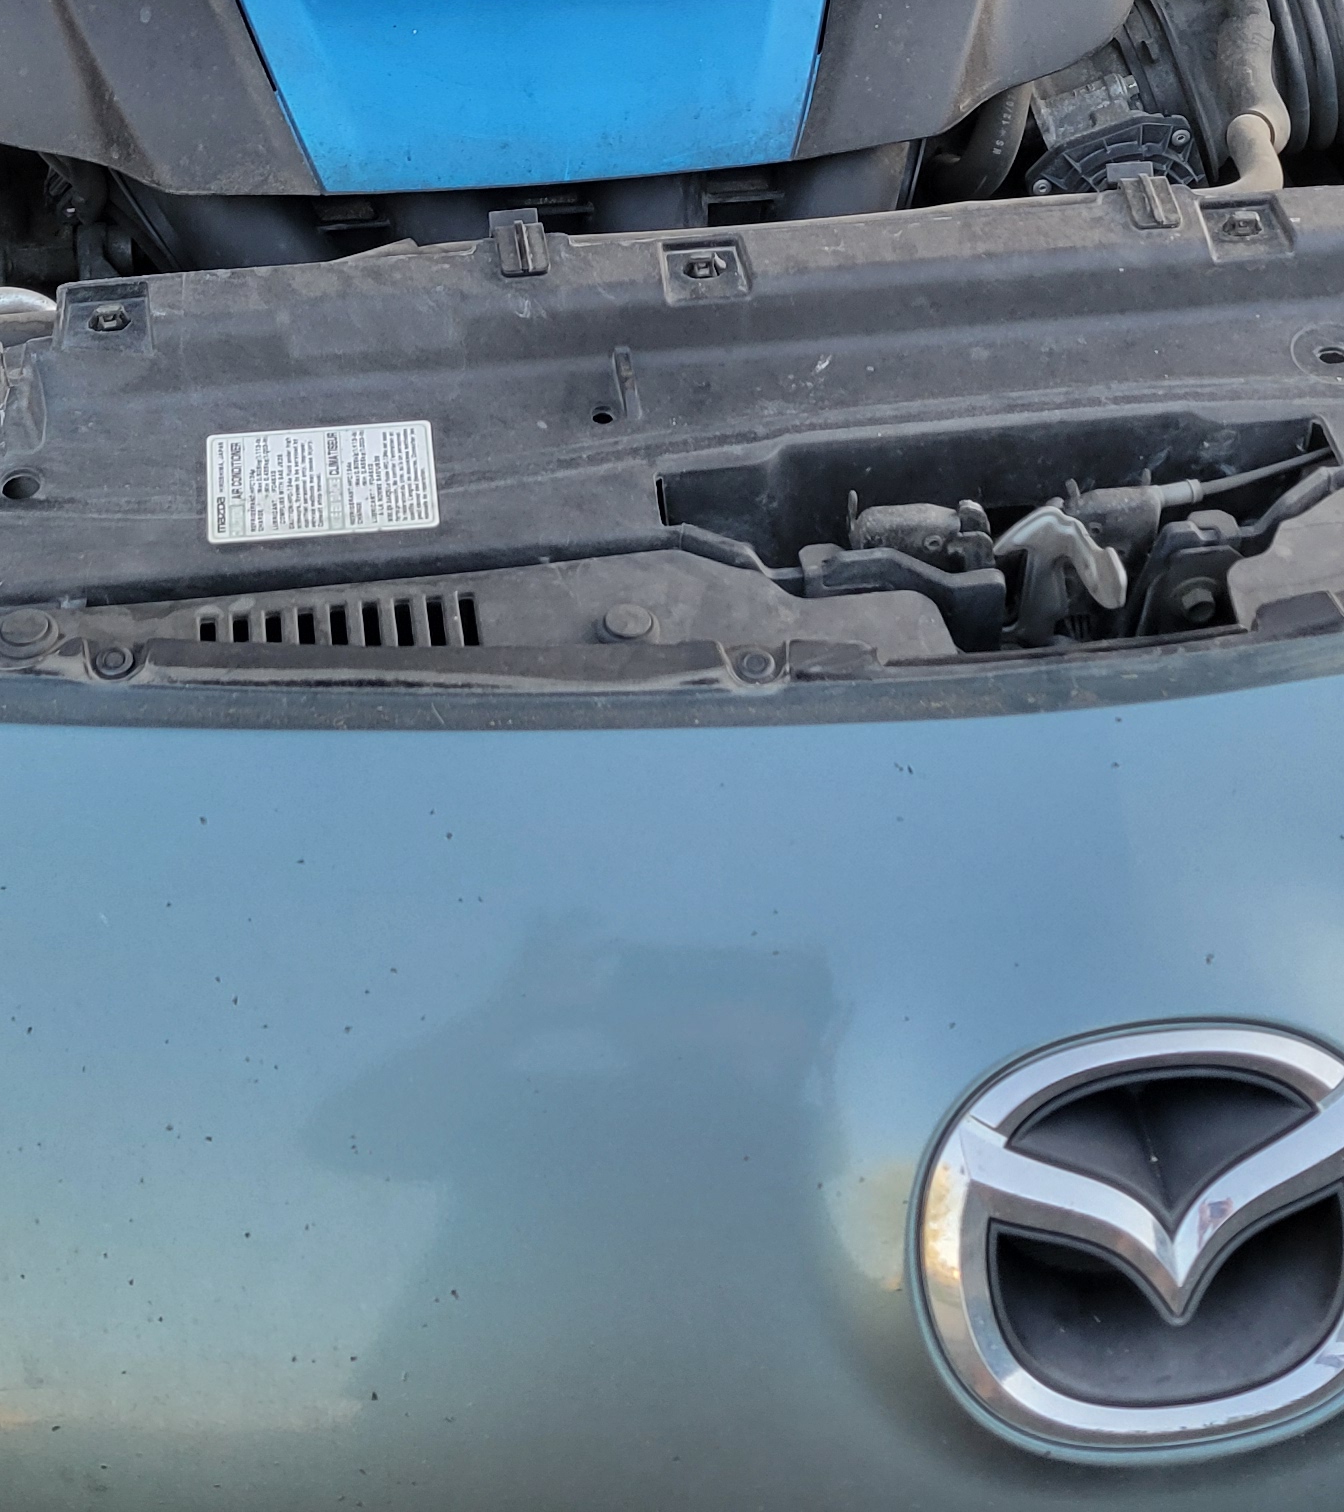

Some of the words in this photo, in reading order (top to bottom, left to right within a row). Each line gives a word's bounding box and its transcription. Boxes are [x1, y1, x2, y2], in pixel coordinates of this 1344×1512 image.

[230, 442, 242, 487] CONDITIONER
[327, 432, 339, 476] CLIMATISEUR
[232, 488, 242, 500] AIR
[217, 496, 226, 533] mazda
